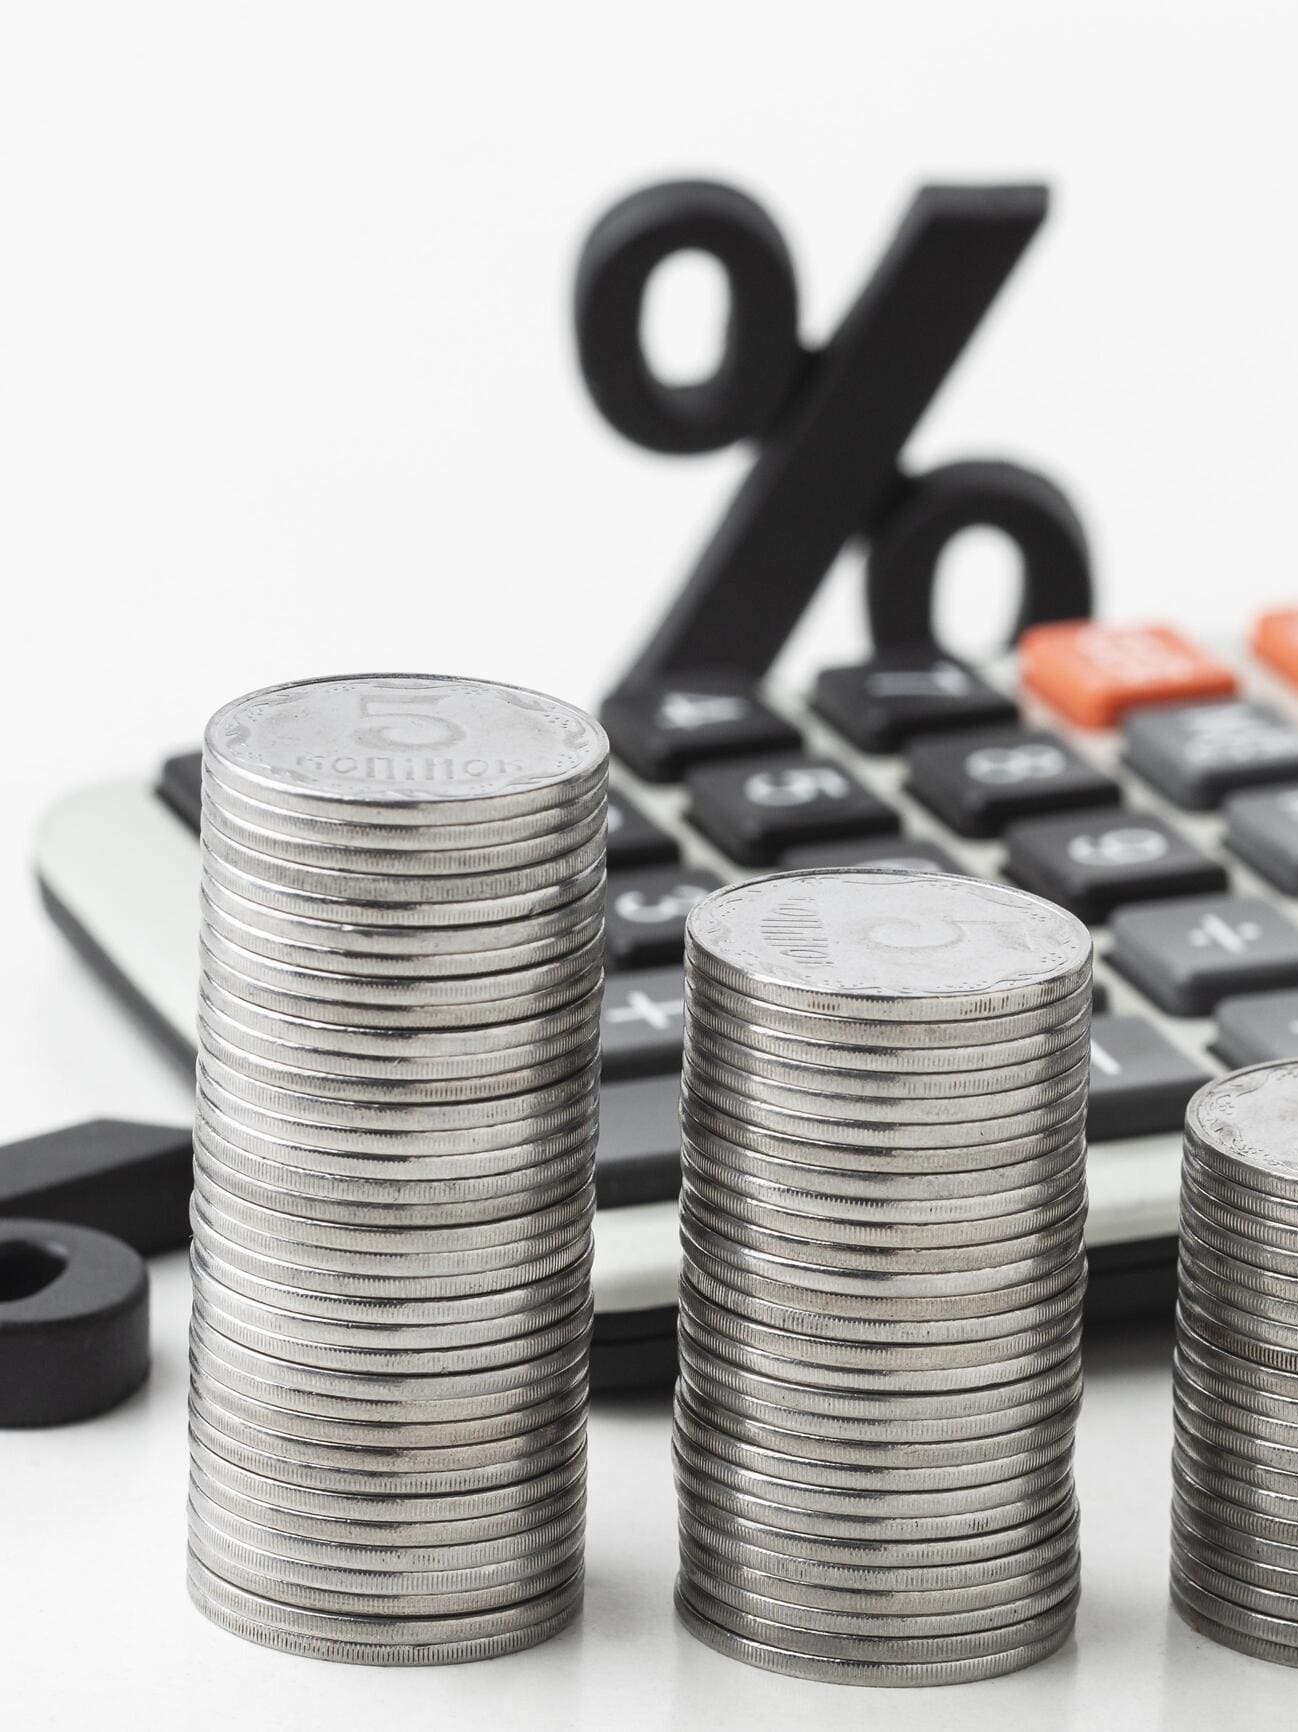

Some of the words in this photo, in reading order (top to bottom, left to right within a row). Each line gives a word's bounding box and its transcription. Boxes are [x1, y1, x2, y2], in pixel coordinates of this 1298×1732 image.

[353, 694, 468, 750] 5
[965, 743, 1067, 784] 8
[743, 767, 850, 807] 5
